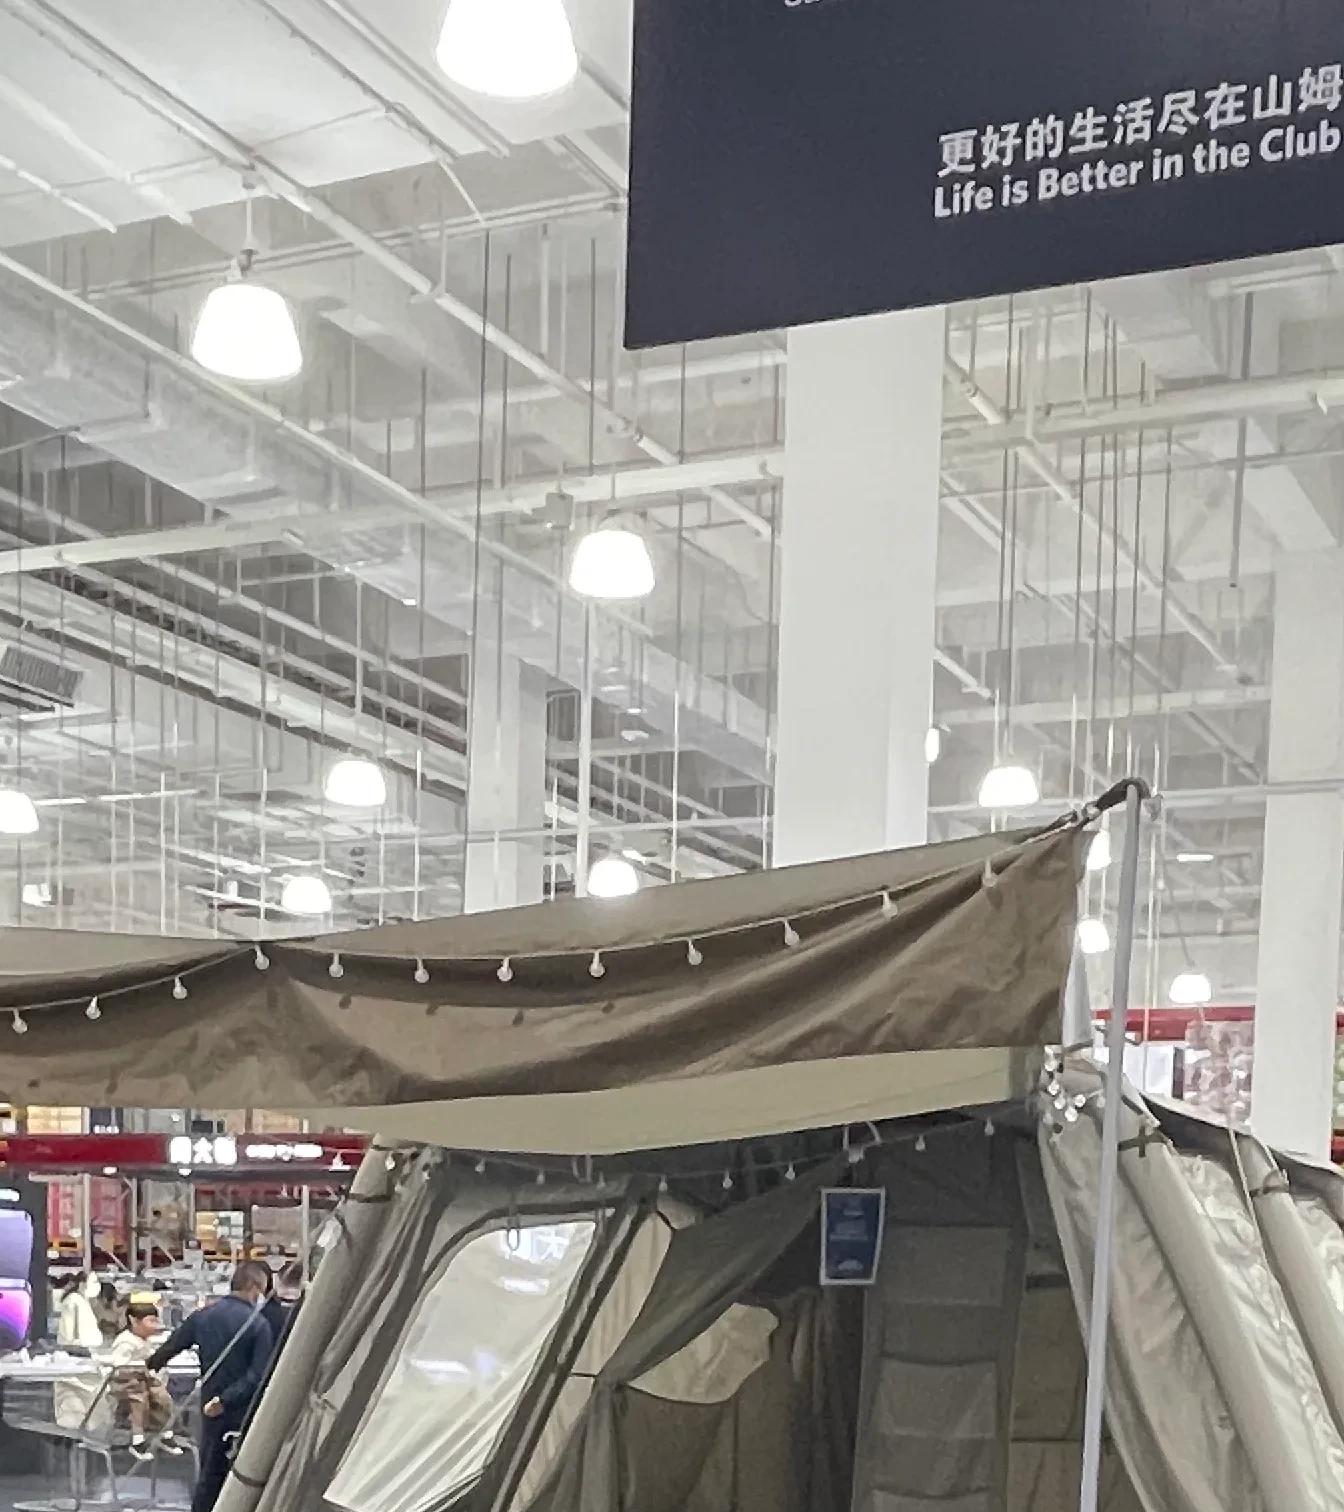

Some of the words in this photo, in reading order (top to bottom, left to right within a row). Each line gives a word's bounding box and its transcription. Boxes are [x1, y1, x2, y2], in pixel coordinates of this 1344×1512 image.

[934, 180, 994, 217] Life
[1001, 174, 1029, 207] is
[1038, 158, 1144, 201] Better
[1153, 148, 1184, 181] in
[1192, 138, 1250, 174] the
[1260, 119, 1341, 162] Club
[936, 63, 1344, 178] 更好的生活尽在山姆
